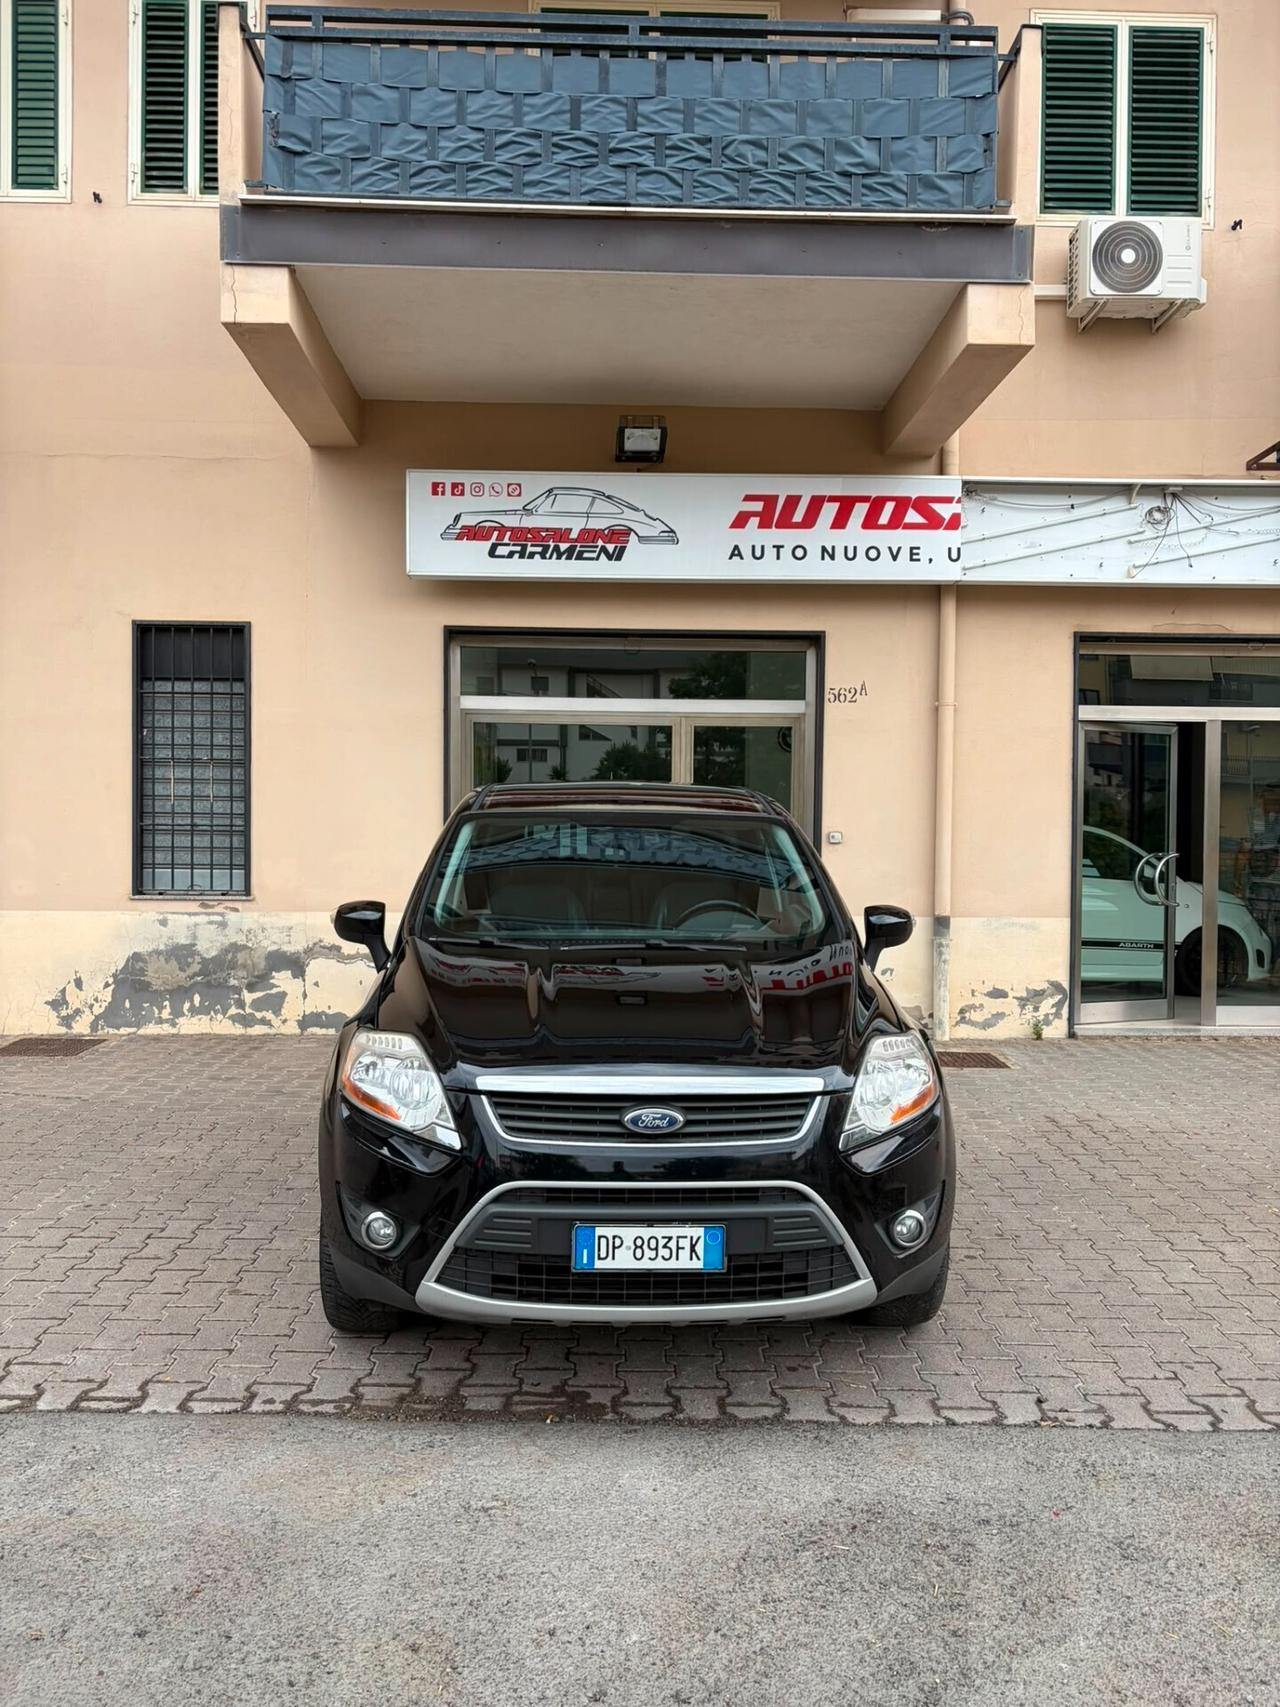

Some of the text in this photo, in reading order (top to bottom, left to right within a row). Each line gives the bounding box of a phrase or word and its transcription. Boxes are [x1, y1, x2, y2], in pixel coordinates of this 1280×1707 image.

[456, 525, 632, 545] AUTOSALONE
[487, 542, 628, 562] CARMENI
[728, 544, 808, 561] AUTO
[820, 545, 934, 565] NUOVE,
[638, 1113, 670, 1128] Ford
[597, 1234, 624, 1262] DP
[632, 1235, 702, 1262] 893FK
